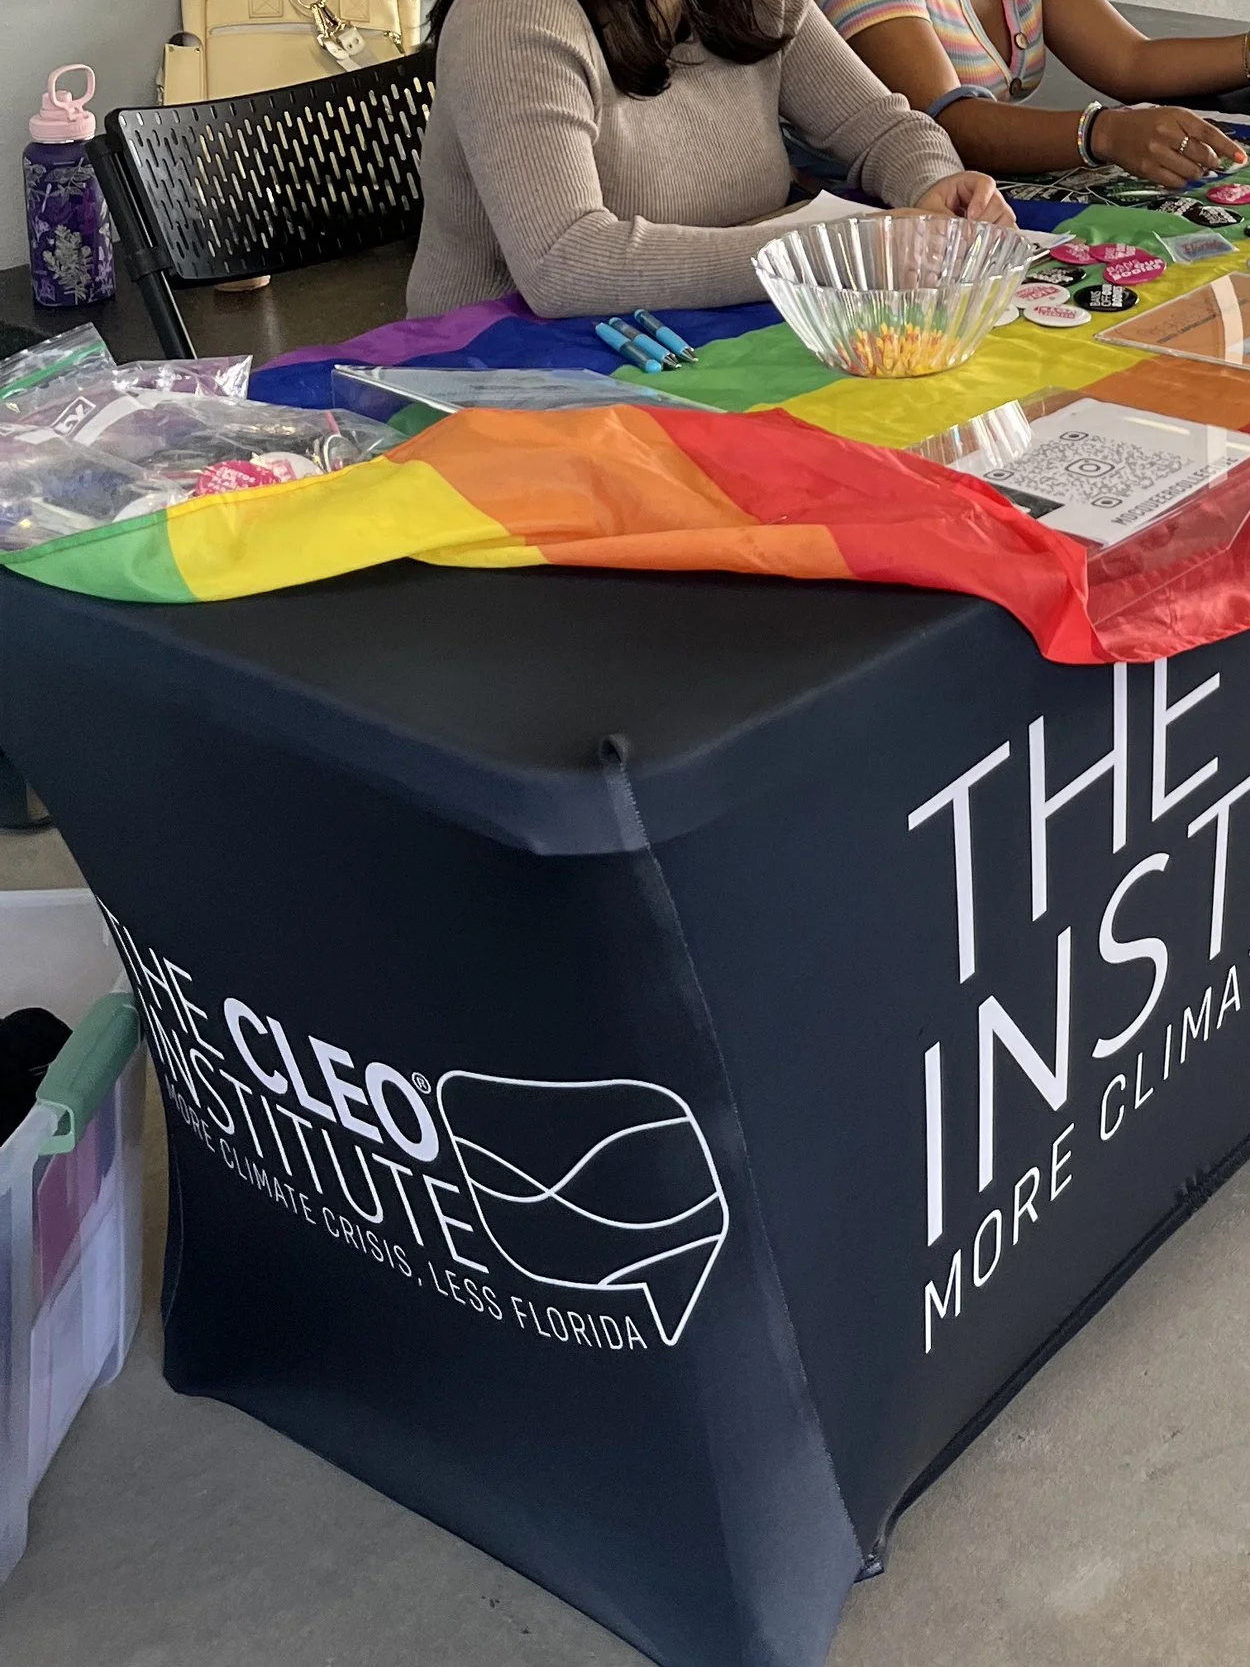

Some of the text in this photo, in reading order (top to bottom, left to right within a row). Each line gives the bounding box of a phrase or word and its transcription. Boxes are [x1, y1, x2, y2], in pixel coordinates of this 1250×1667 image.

[907, 657, 1221, 985] THE
[96, 895, 226, 1061] THE
[137, 986, 490, 1275] INSTITUTE
[164, 1073, 649, 1351] MORE CLIMATE CRISIS, LESS FLORIDA
[924, 1122, 1075, 1354] MORE
